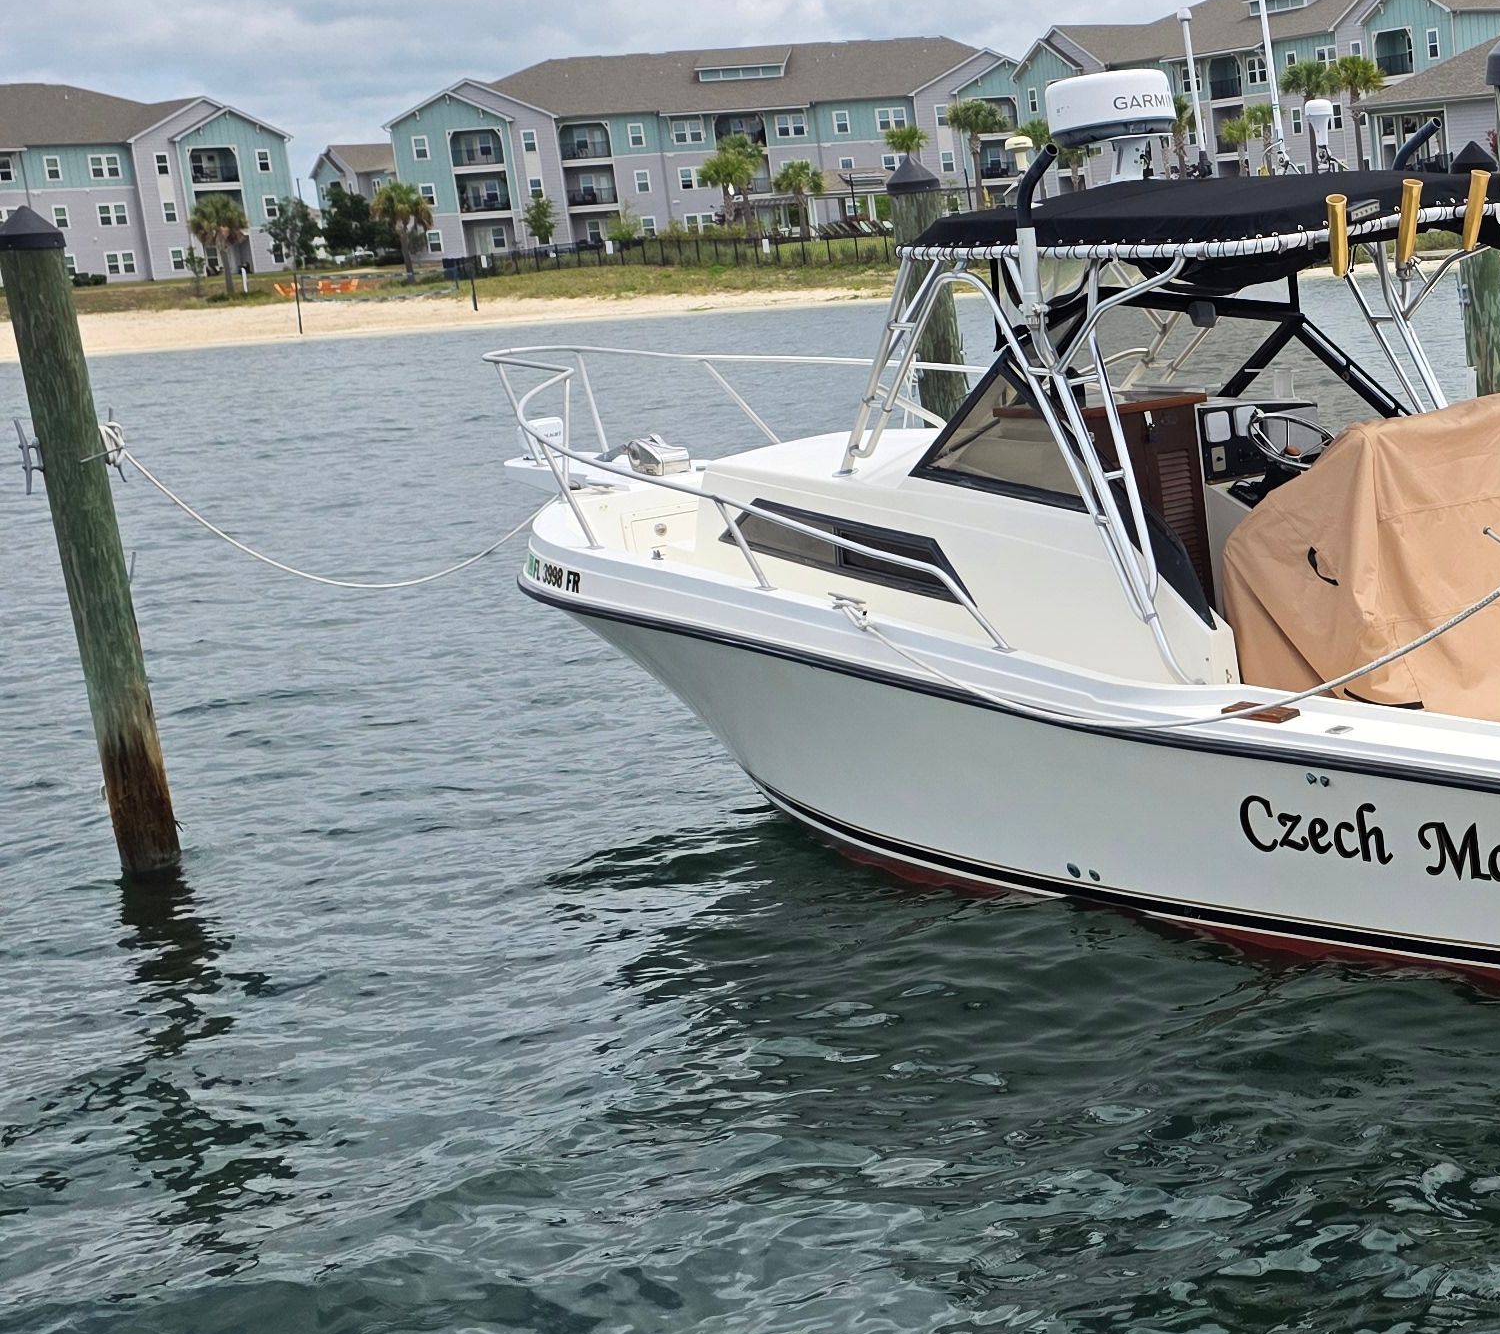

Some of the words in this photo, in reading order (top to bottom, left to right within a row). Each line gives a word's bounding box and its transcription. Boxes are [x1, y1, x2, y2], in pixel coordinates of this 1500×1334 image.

[532, 558, 541, 581] FL
[565, 570, 581, 594] FR
[1239, 795, 1394, 866] Czech
